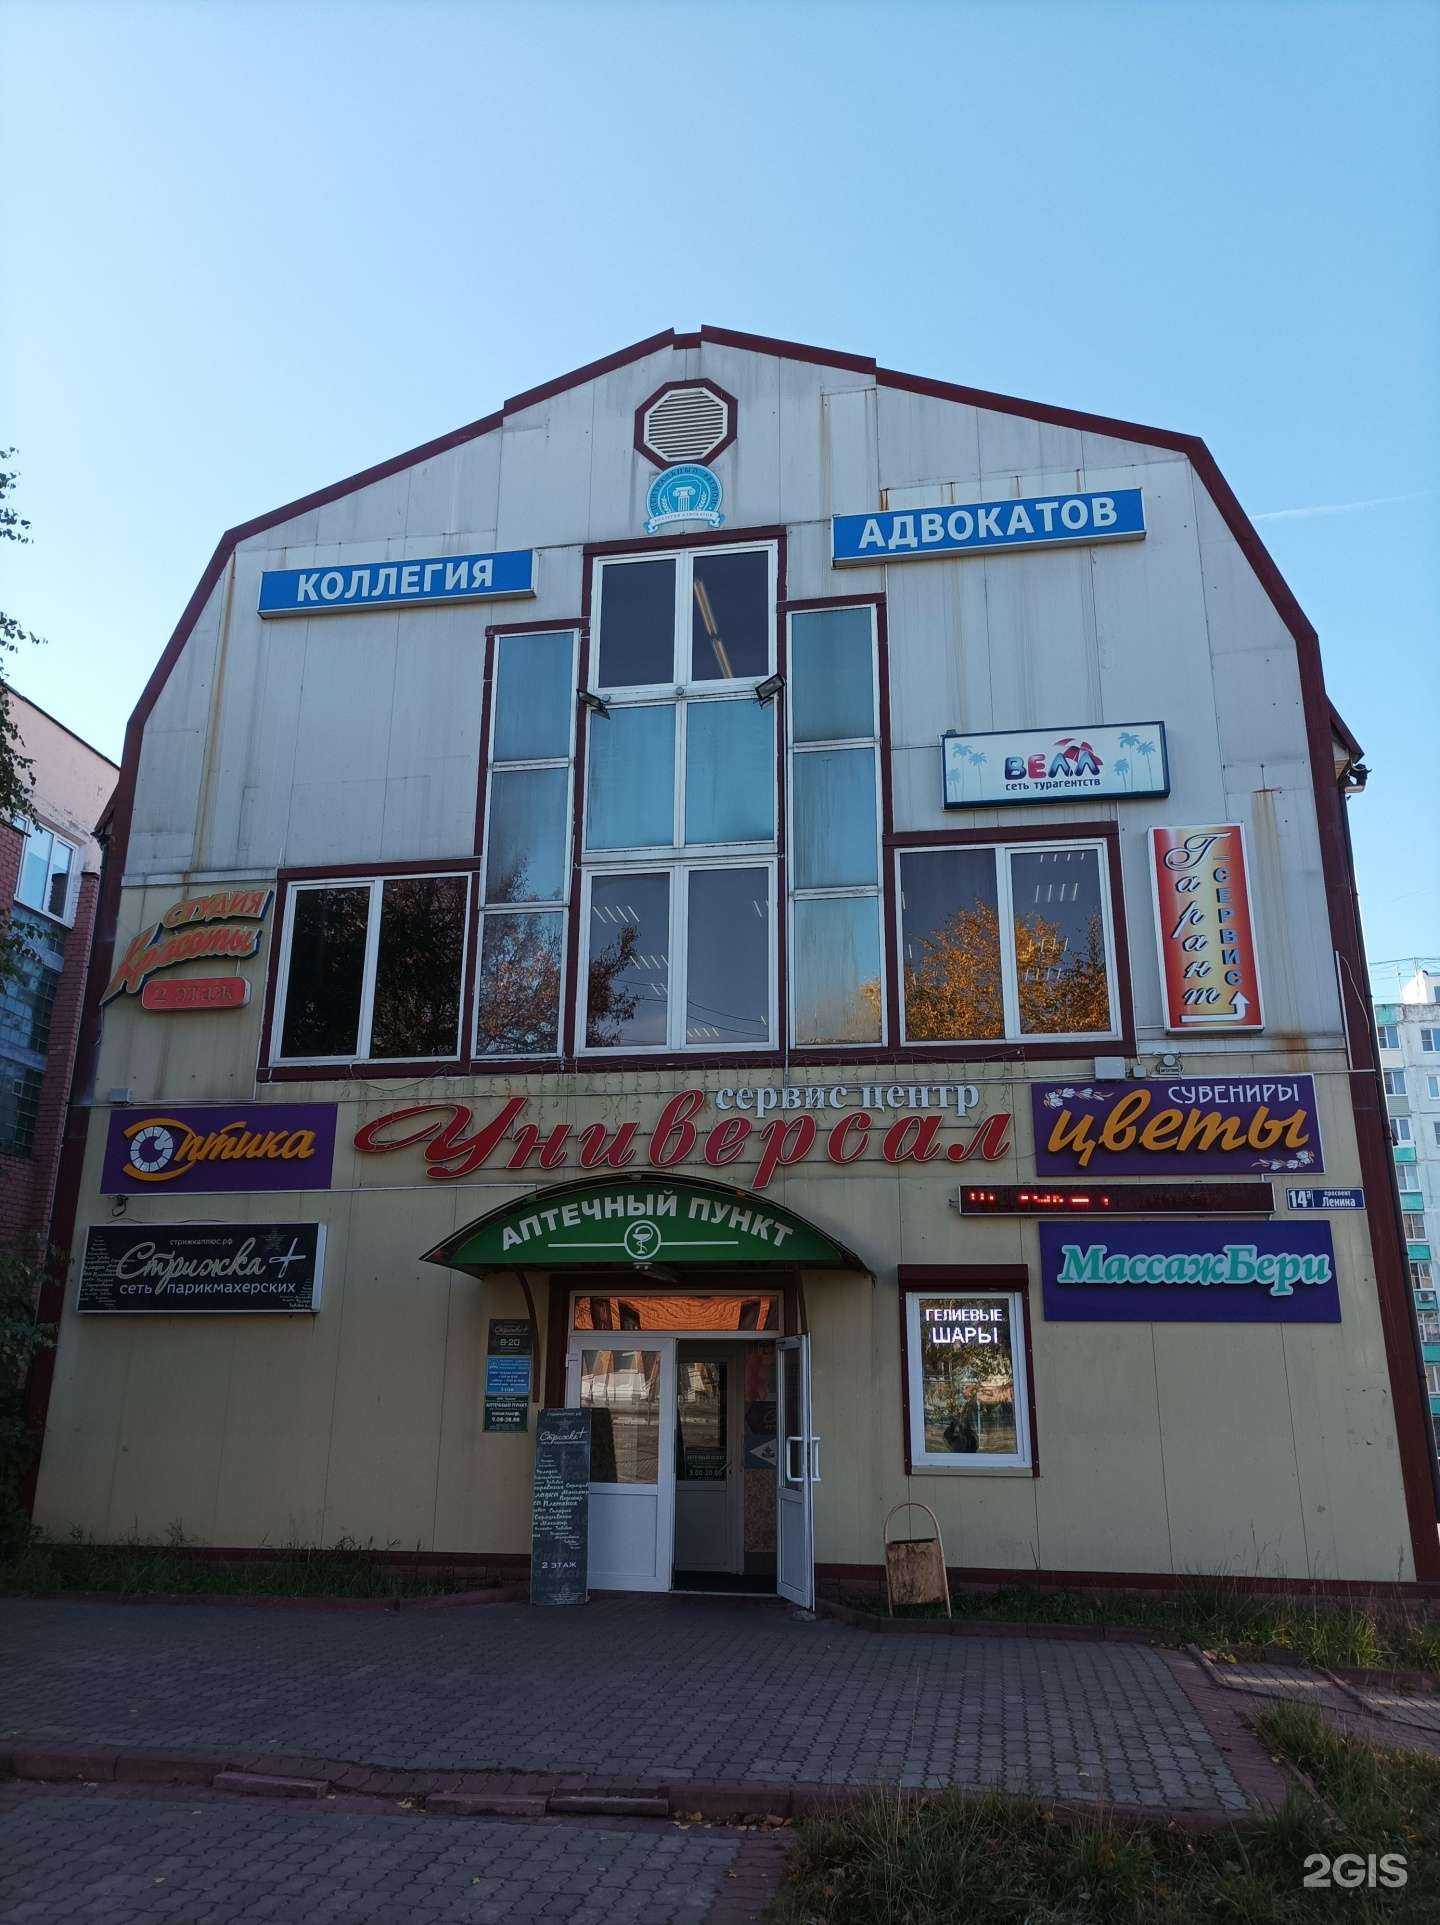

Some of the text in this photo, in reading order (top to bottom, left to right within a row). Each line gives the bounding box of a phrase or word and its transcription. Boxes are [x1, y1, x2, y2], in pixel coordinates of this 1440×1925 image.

[858, 497, 1118, 550] АДВОКАТОВ
[297, 559, 493, 602] КОЛЛЕГИЯ
[1005, 777, 1101, 791] сеть турагентств
[154, 989, 167, 1001] 2
[715, 1084, 980, 1118] сервис центр
[1168, 1084, 1299, 1104] СУВЕНИРЫ
[354, 1089, 1012, 1190] Универсал
[1322, 1197, 1356, 1208] Ленина
[502, 1191, 795, 1251] АПТЕЧНЫЙ ПУНКТ
[116, 1237, 267, 1296] Стрижка
[1057, 1245, 1332, 1296] МассажБери
[119, 1281, 296, 1297] сеть парикмахерских
[925, 1309, 1003, 1321] ГЕЛИЕВЫЕ
[932, 1327, 998, 1344] ШАРЫ
